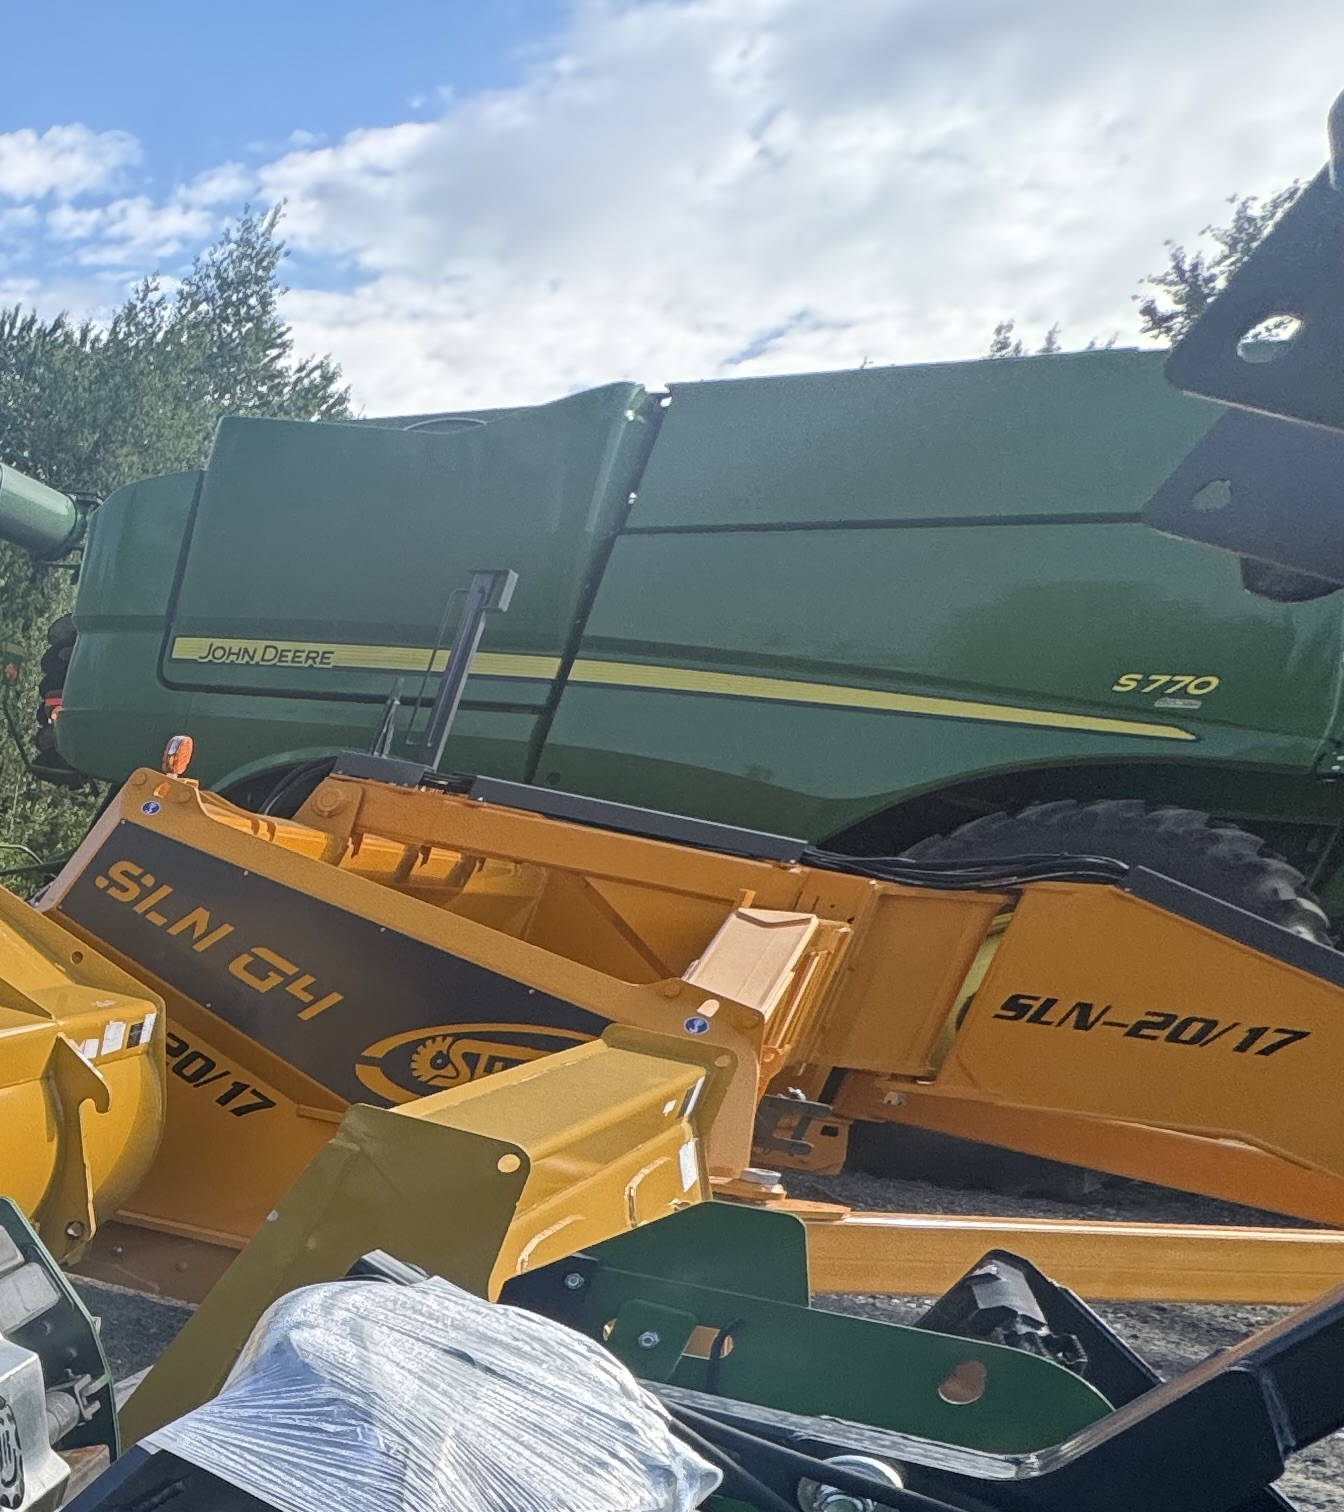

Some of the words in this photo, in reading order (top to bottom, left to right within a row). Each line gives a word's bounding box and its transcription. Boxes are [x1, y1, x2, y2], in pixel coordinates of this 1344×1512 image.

[199, 643, 257, 663] JOHN
[262, 645, 335, 666] DEERE
[1112, 673, 1220, 695] S770
[95, 860, 235, 953] SLN
[228, 947, 344, 1021] G4
[992, 993, 1311, 1056] SLN-20/17
